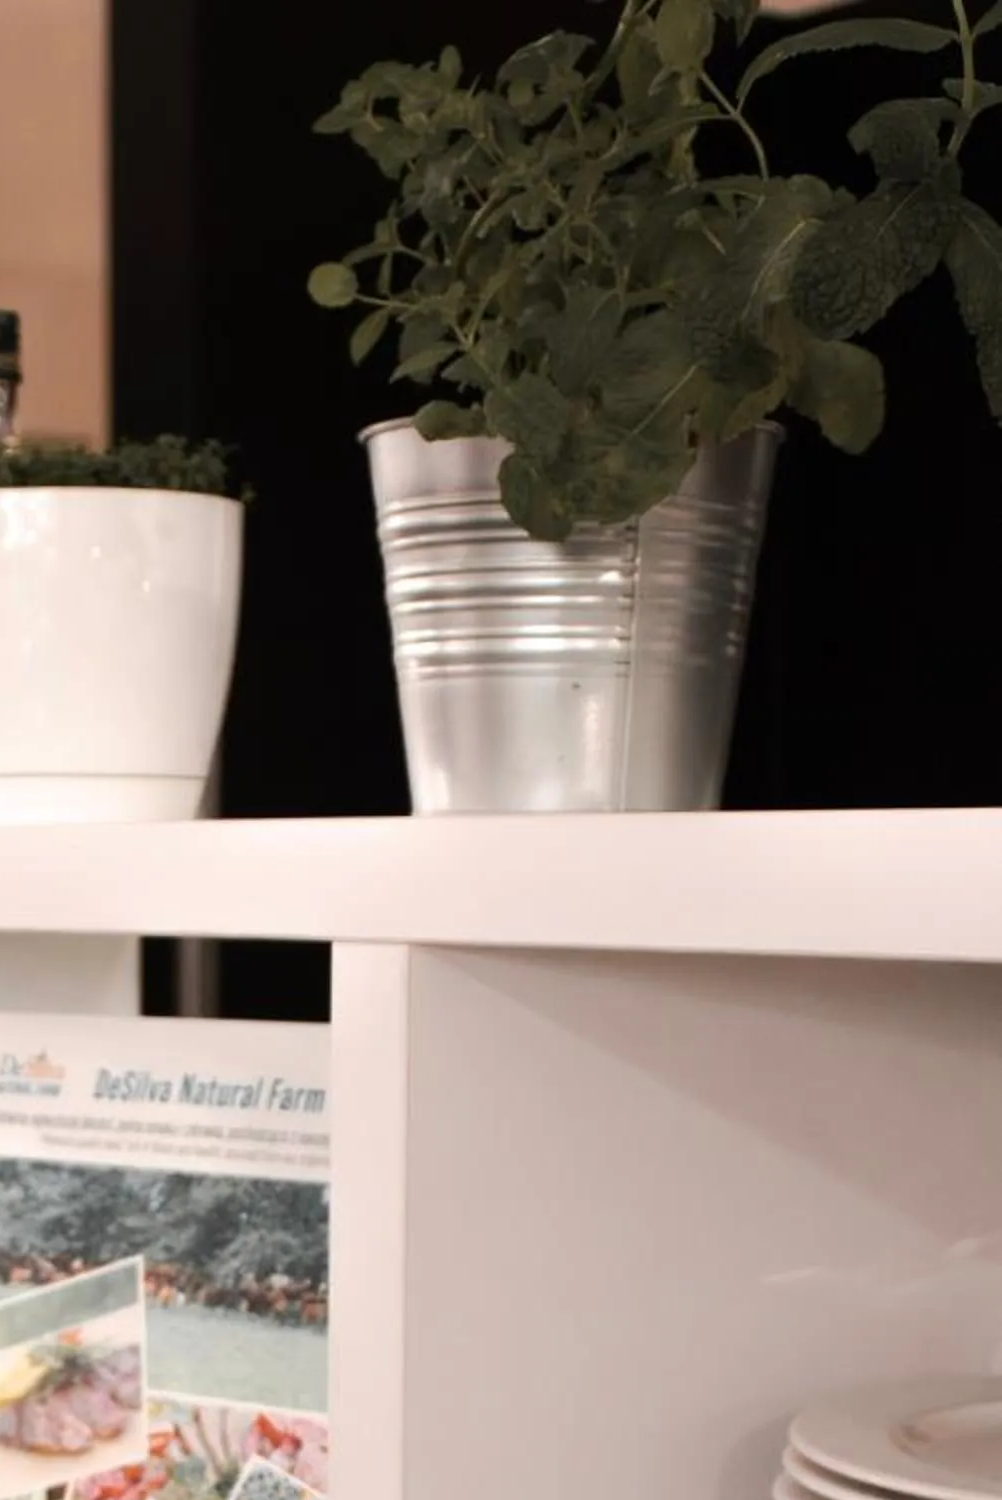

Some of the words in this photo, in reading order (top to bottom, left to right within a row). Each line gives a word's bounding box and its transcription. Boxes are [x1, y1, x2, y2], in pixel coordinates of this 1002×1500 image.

[93, 1067, 172, 1103] DeSilva
[179, 1072, 264, 1110] Natural
[267, 1077, 326, 1113] Farm
